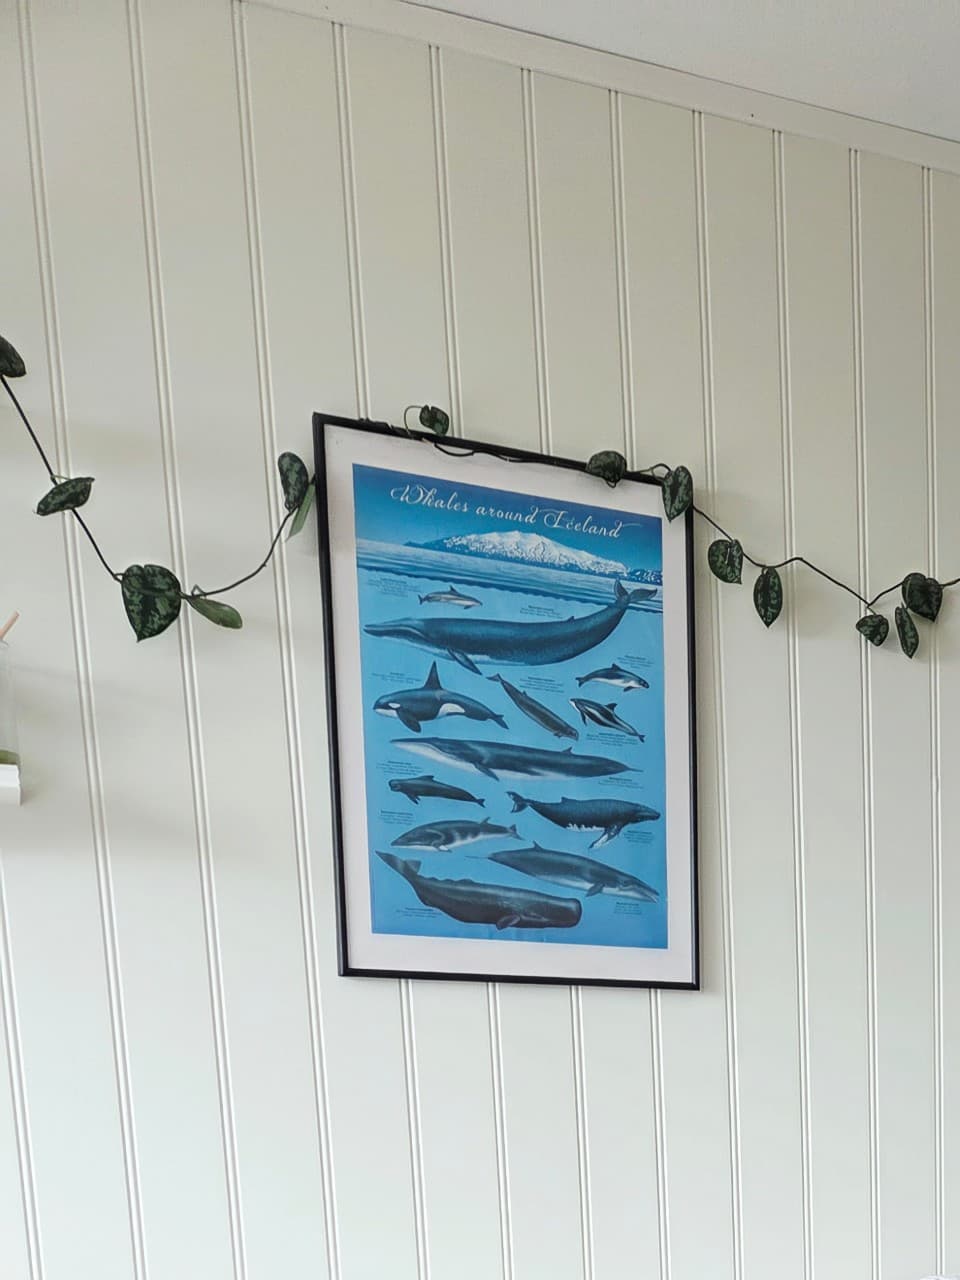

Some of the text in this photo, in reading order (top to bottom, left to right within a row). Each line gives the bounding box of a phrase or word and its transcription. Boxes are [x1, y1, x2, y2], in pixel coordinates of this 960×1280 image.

[390, 484, 642, 539] Whales around Iceland
